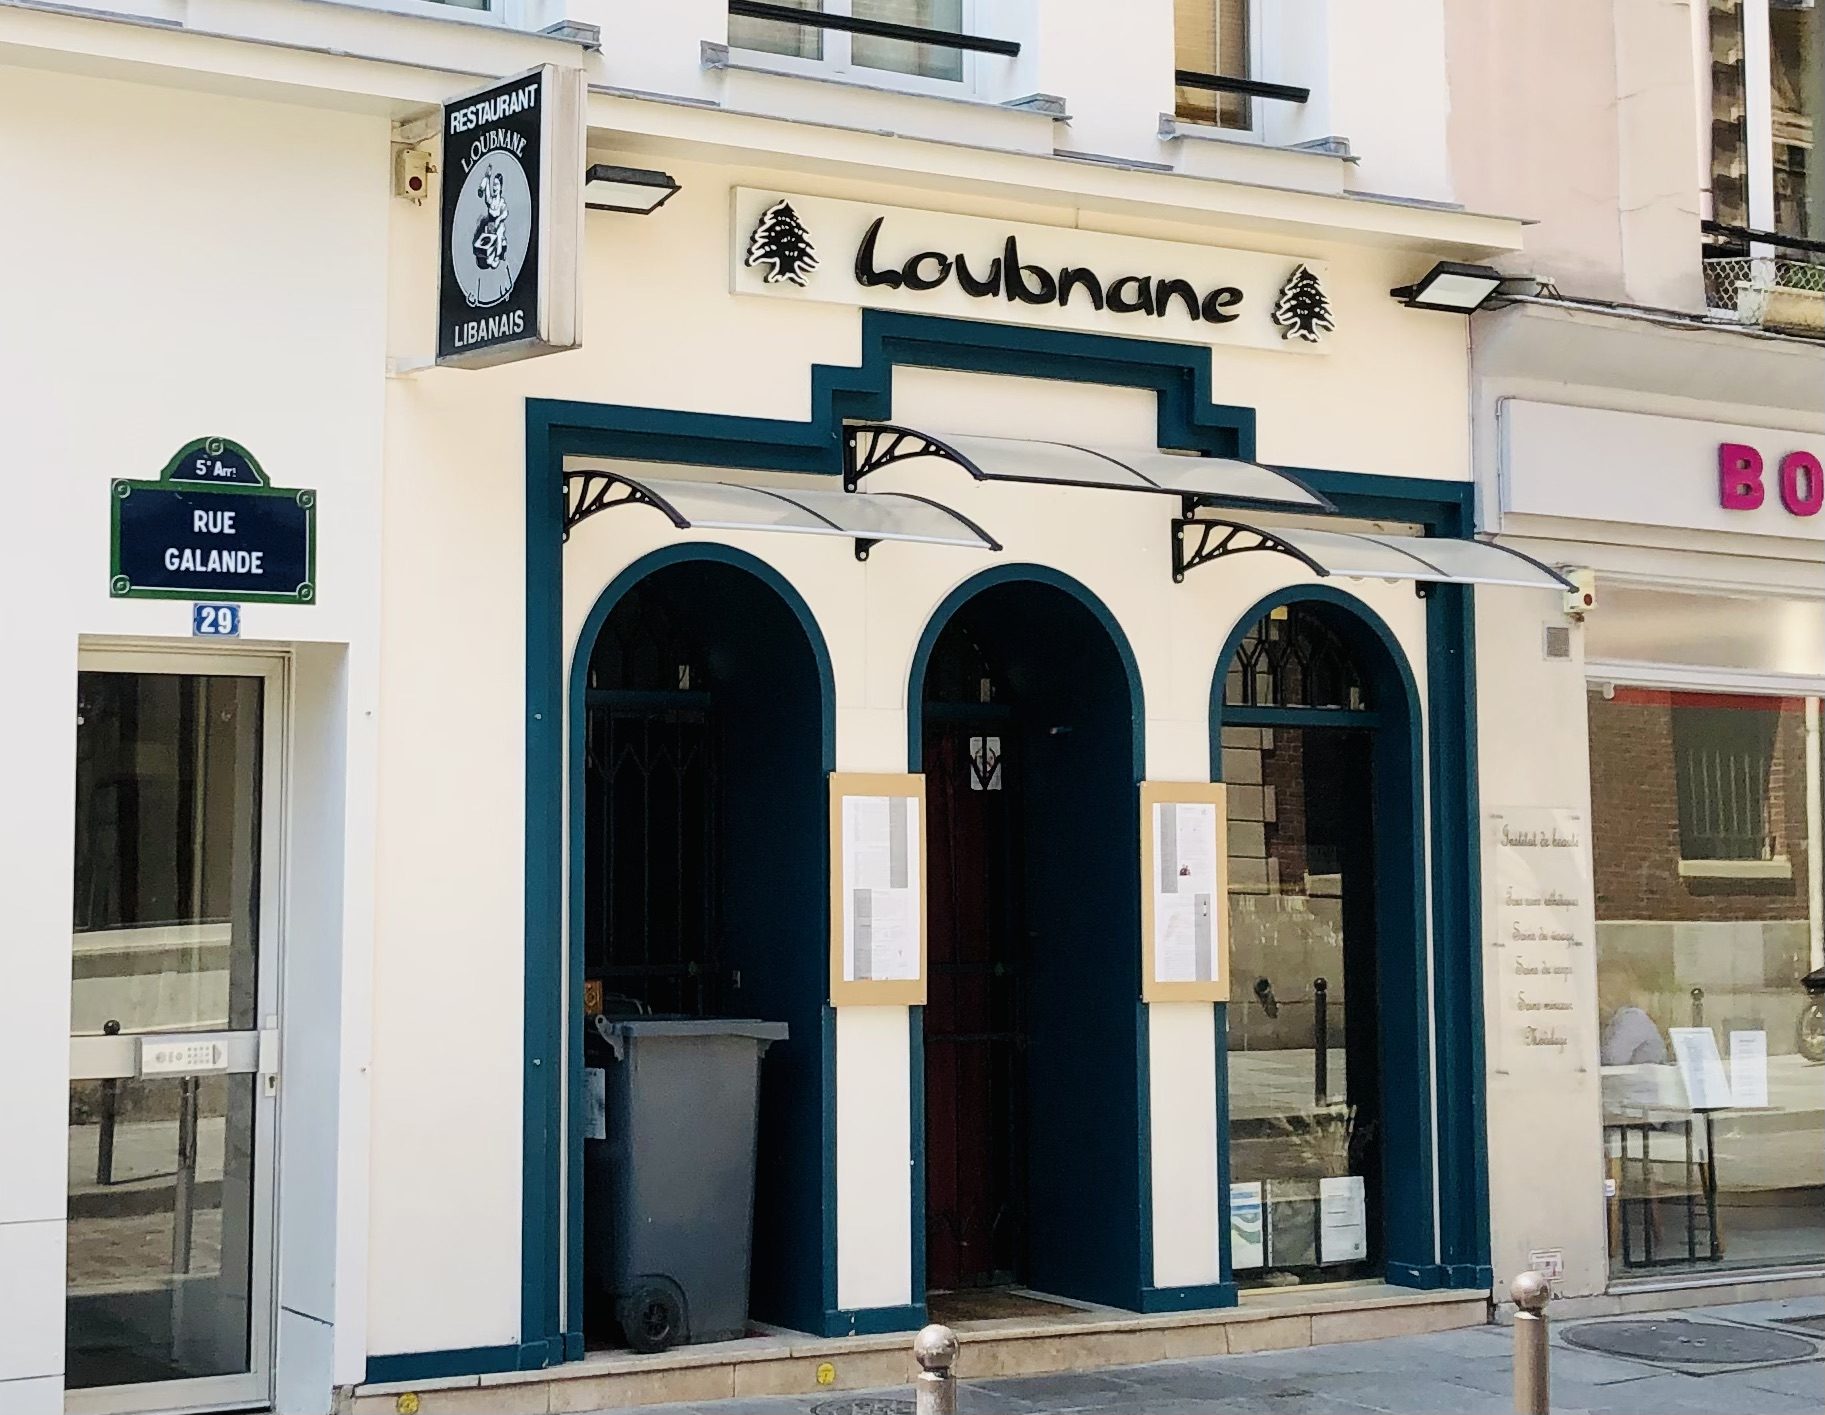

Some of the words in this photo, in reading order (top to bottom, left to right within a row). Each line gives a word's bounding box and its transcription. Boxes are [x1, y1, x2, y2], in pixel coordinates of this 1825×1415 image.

[450, 84, 538, 135] RESTAURANT
[461, 128, 527, 174] LOUBNANE
[855, 216, 1244, 325] Loubnane
[454, 309, 524, 348] LIBANAIS
[193, 509, 236, 535] RUE
[164, 548, 264, 575] GALANDE
[200, 607, 233, 634] 29
